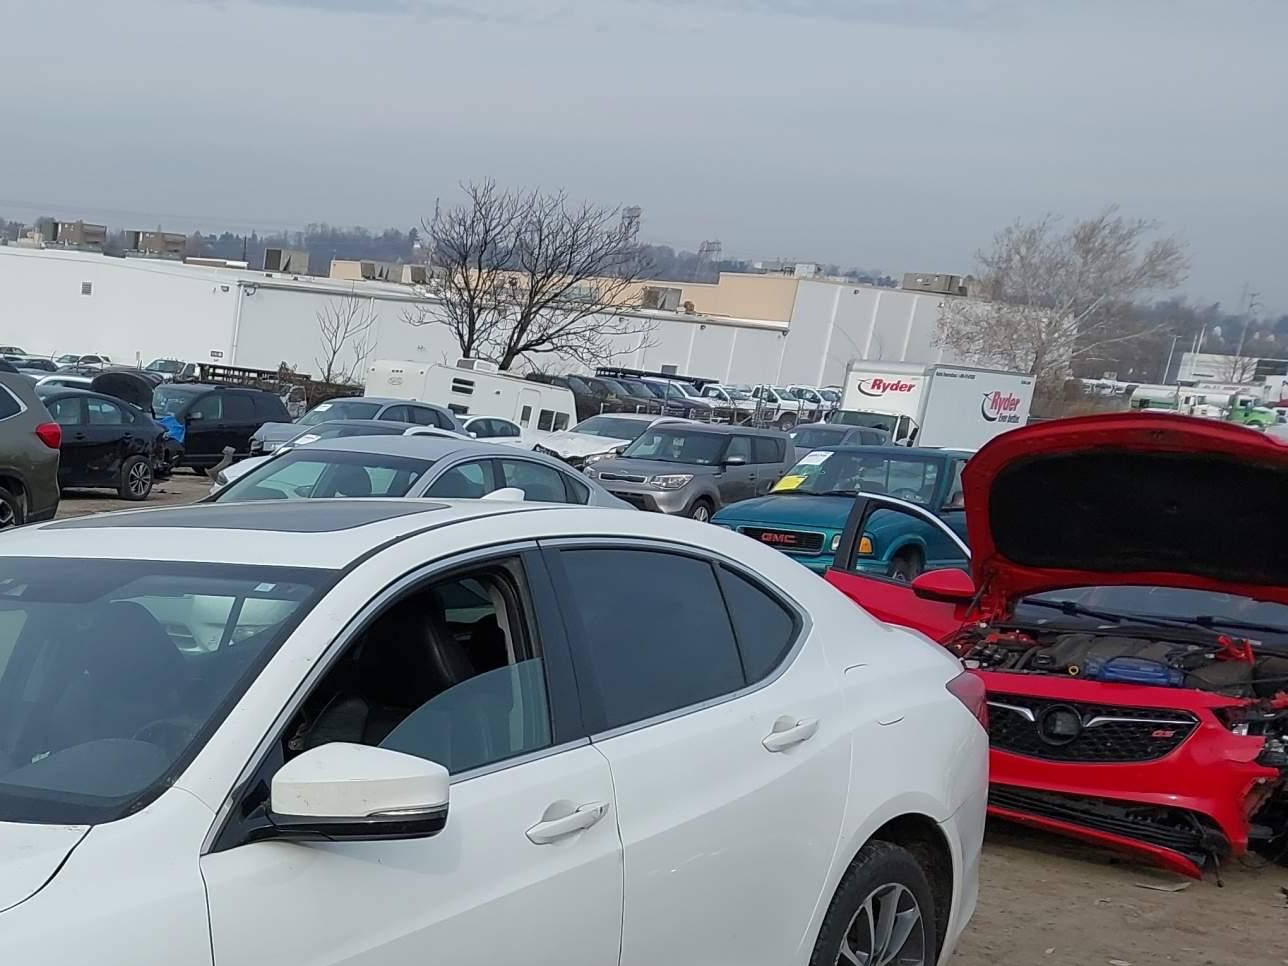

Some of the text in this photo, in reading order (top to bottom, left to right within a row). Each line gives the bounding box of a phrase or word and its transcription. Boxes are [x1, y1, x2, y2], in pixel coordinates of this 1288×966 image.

[870, 378, 916, 393] Ryder
[989, 391, 1020, 414] Ryder
[761, 532, 797, 543] GMC
